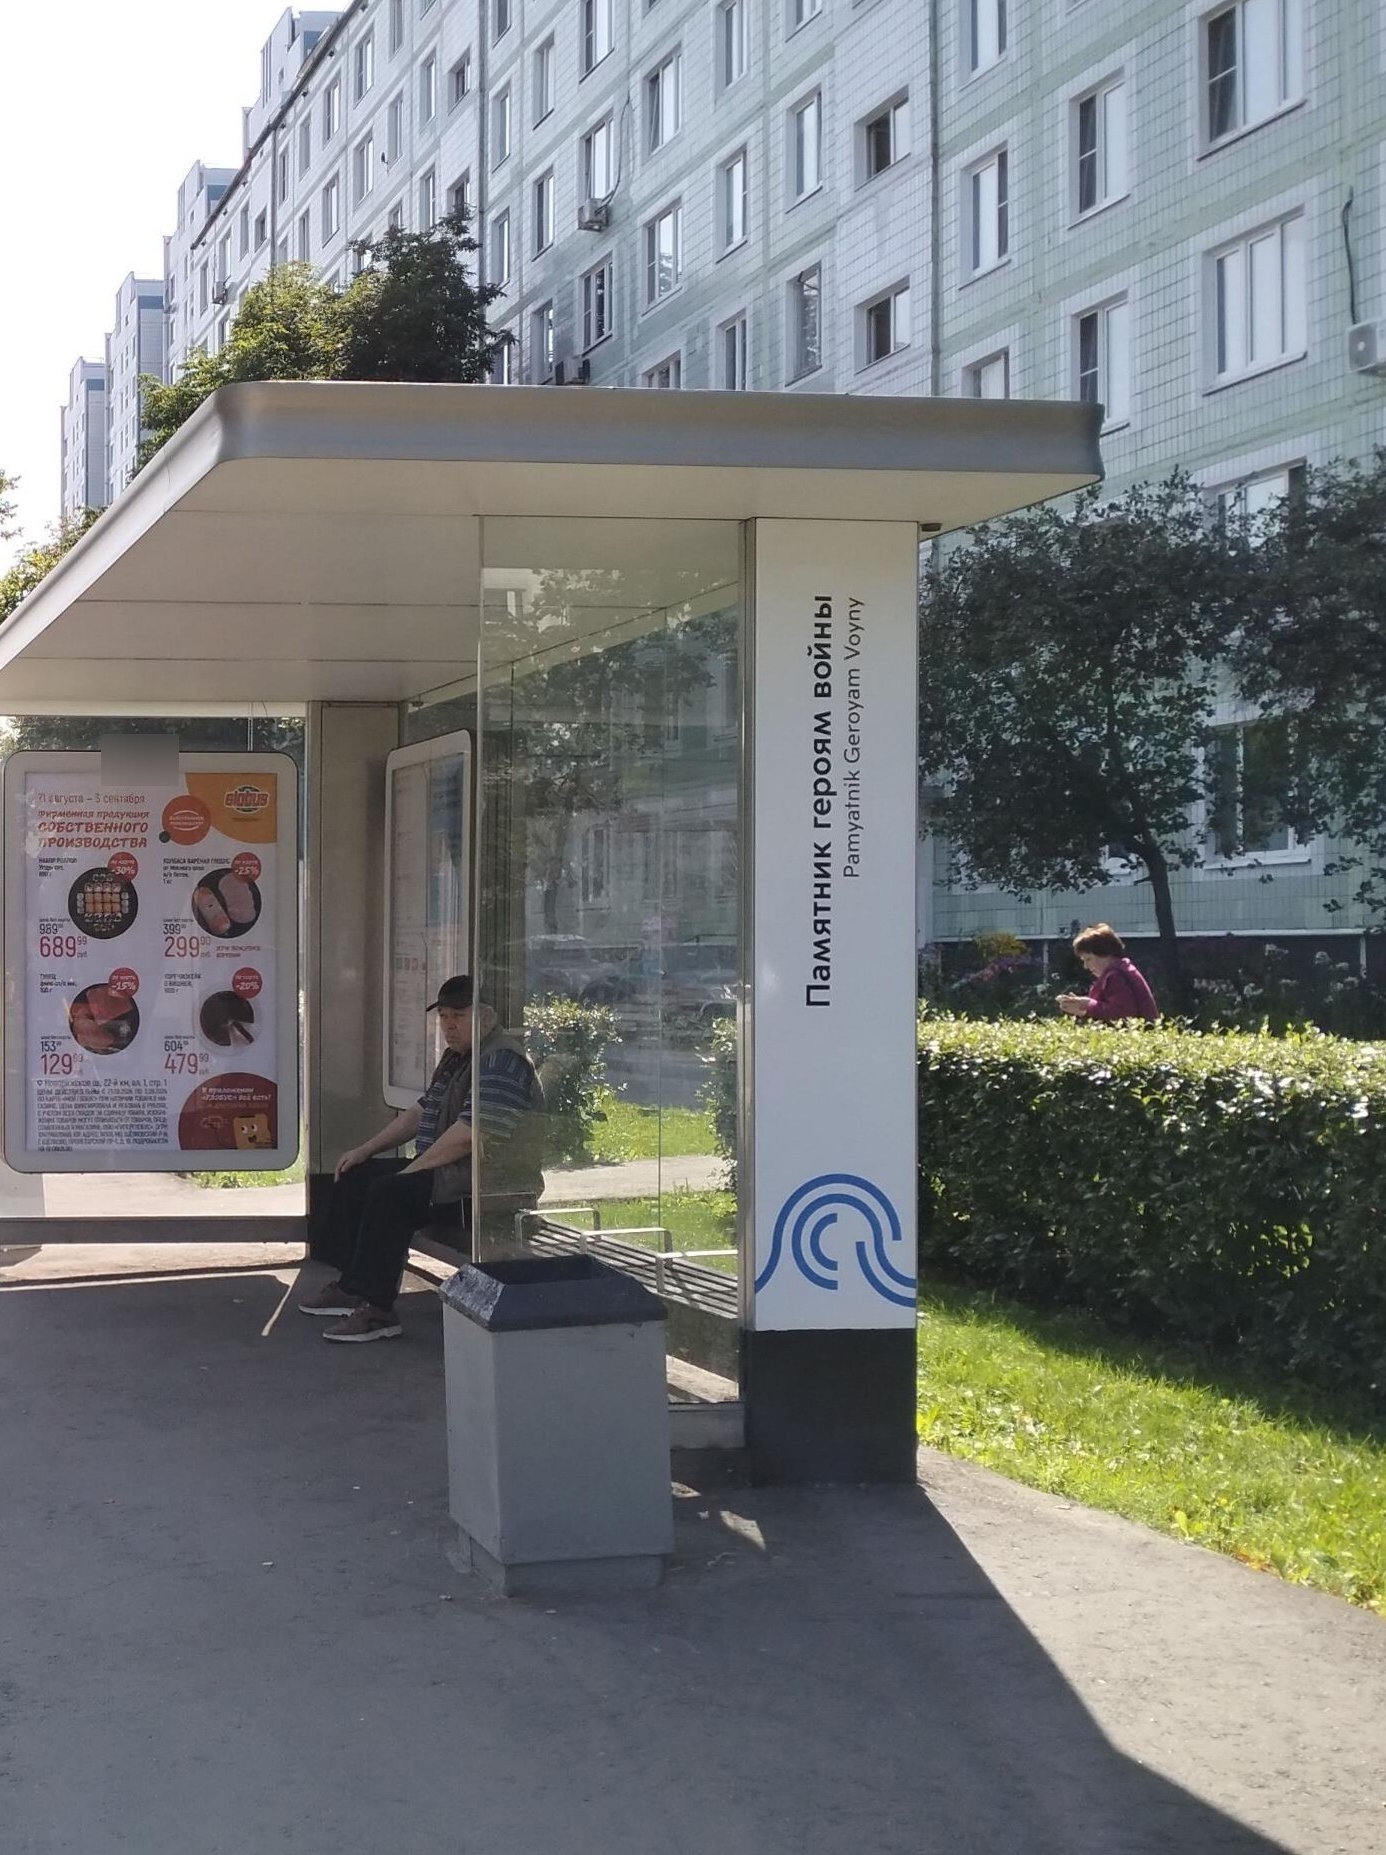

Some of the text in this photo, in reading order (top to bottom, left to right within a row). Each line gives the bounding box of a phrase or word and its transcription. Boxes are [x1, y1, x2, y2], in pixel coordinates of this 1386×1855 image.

[843, 597, 865, 878] Pamyatnik Geroyam Voyny
[48, 794, 84, 805] августа
[103, 792, 146, 805] сентября
[806, 596, 838, 1007] Памятник героям войны
[97, 811, 150, 820] продукция
[38, 821, 149, 833] СОБСТВЕННОГО
[38, 837, 148, 850] ПРОИЗВОДСТВА
[111, 866, 135, 875] -30%
[234, 866, 258, 876] -25%
[40, 924, 58, 935] 989
[163, 924, 181, 935] 399
[40, 936, 77, 958] 689
[164, 936, 200, 958] 299
[112, 982, 137, 991] -15%
[235, 982, 260, 991] -20%
[41, 1041, 57, 1052] 153
[164, 1040, 183, 1052] 604
[41, 1053, 73, 1075] 129
[164, 1053, 199, 1075] 479
